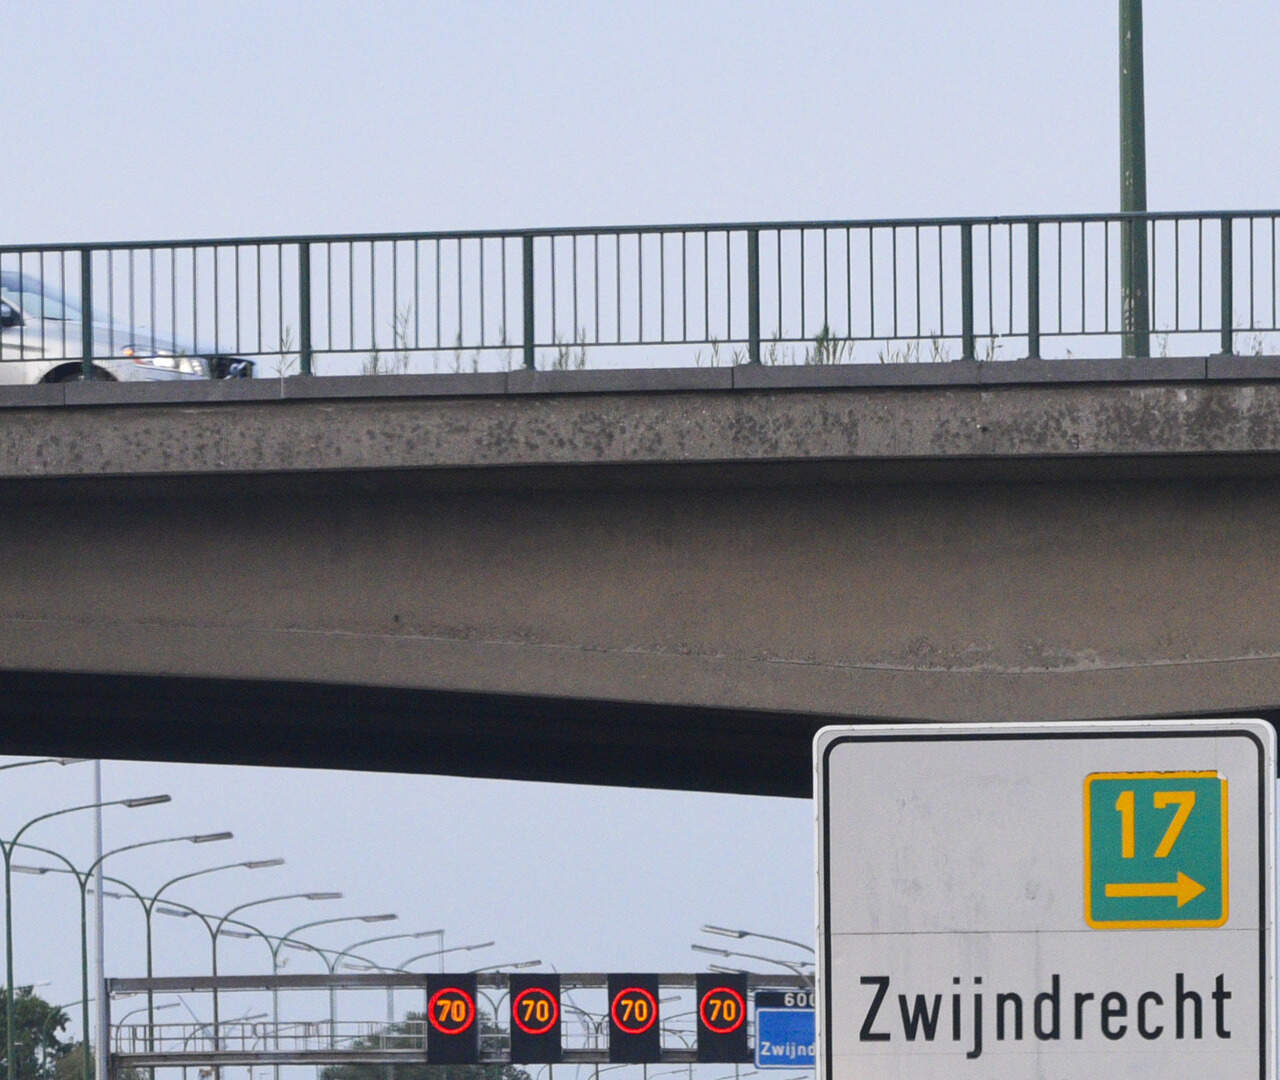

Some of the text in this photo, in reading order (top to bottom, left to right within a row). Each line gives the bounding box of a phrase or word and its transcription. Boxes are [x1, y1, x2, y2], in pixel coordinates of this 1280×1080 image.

[1115, 791, 1196, 858] 17
[436, 1000, 466, 1022] 70
[522, 1000, 550, 1022] 70
[620, 1000, 648, 1022] 70
[709, 999, 737, 1022] 70
[858, 972, 1232, 1059] Zwijndrecht
